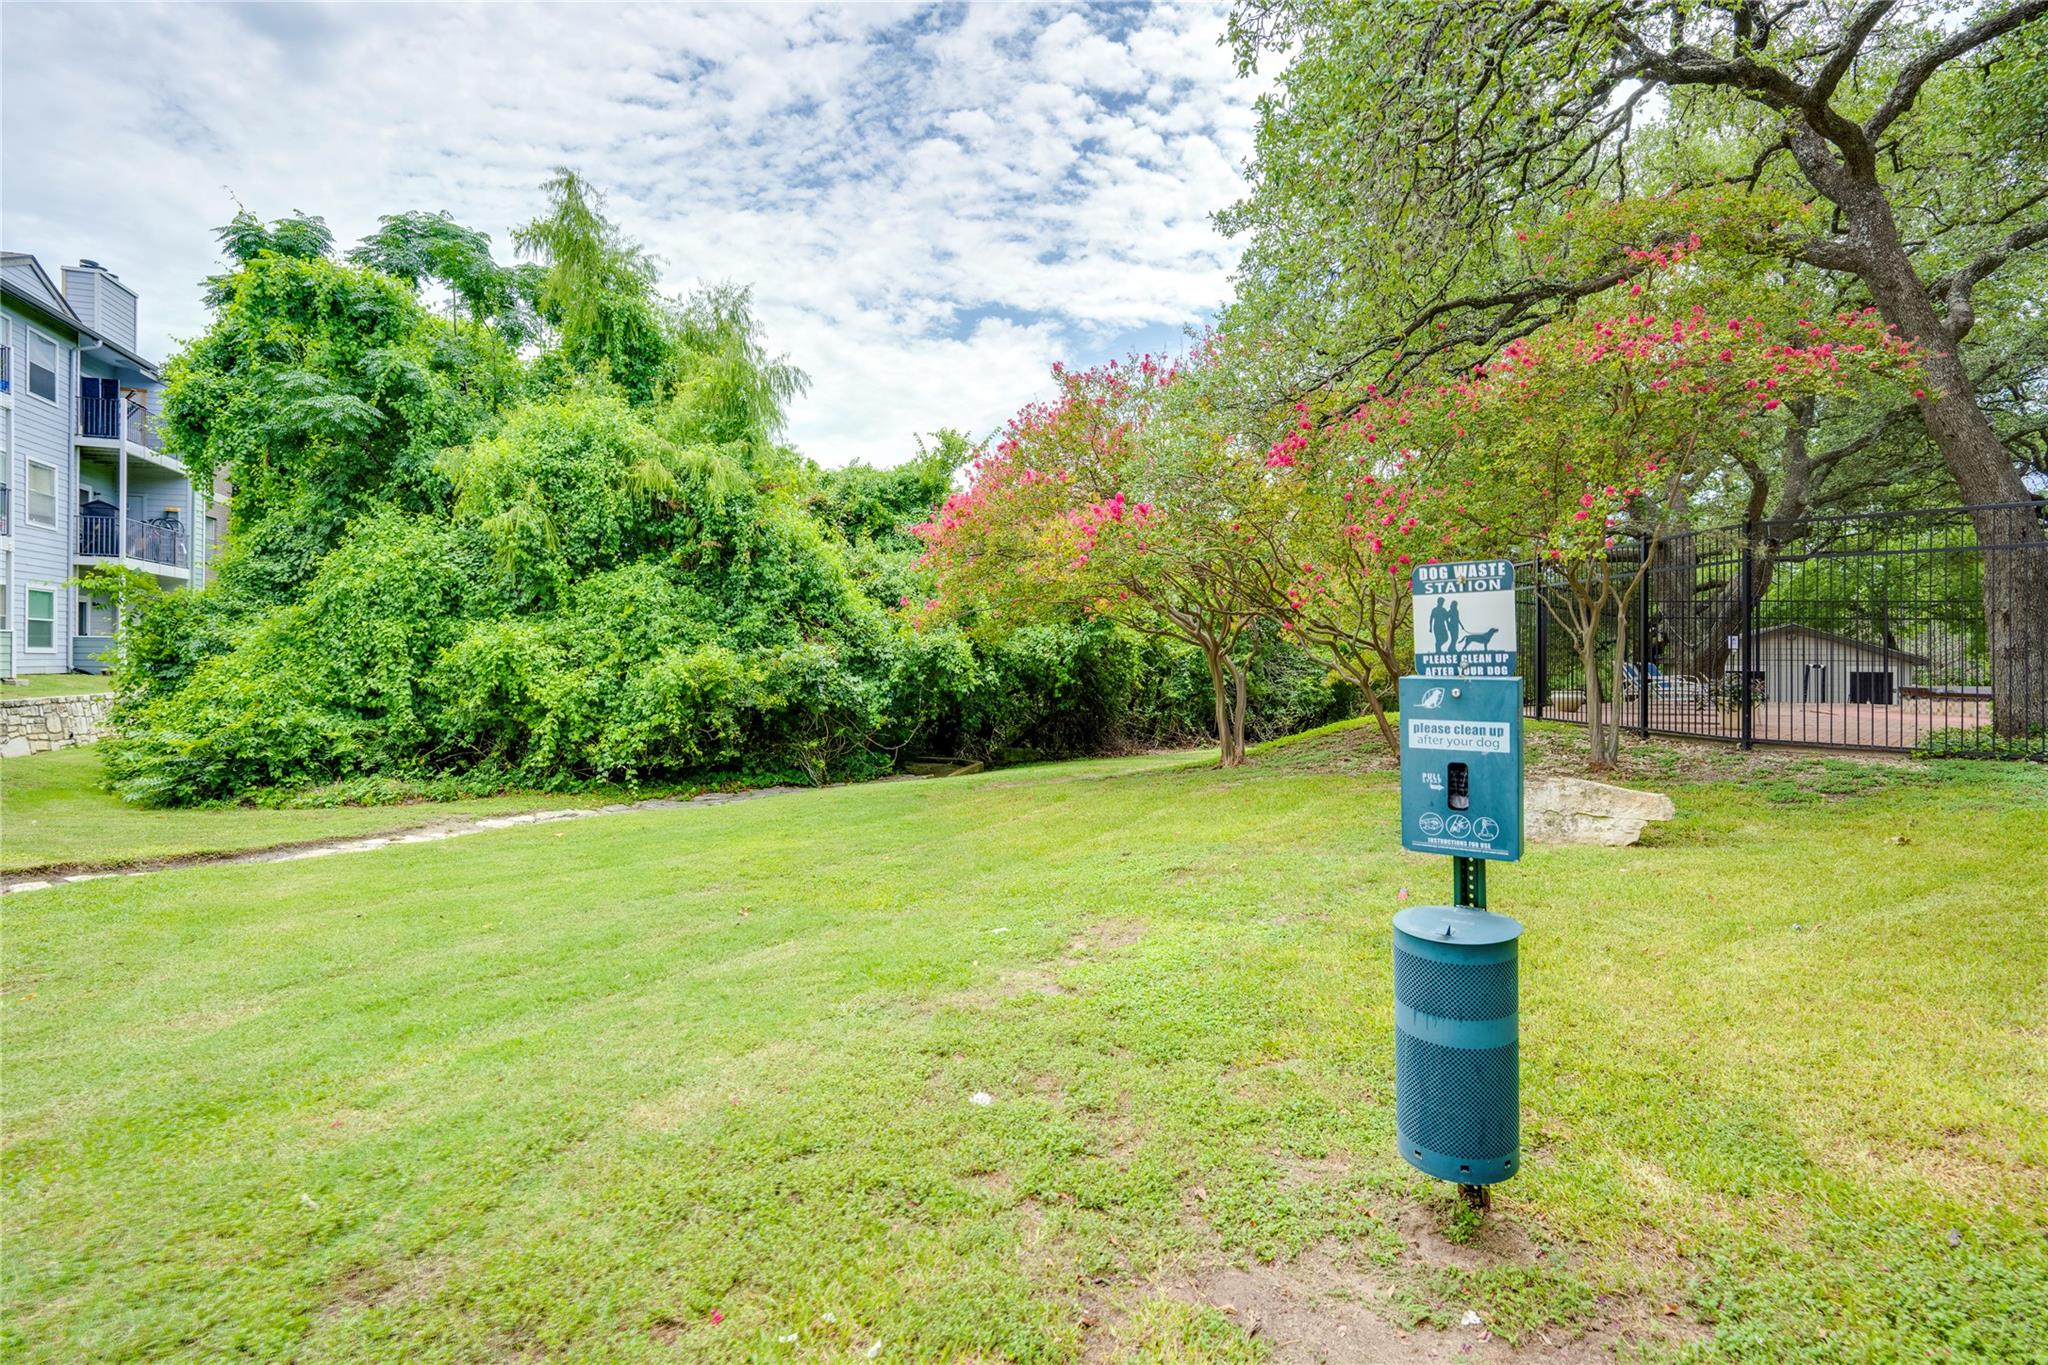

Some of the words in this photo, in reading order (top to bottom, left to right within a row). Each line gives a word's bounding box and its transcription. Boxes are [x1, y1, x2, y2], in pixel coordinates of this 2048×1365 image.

[1419, 567, 1448, 580] DOG
[1453, 562, 1506, 578] WASTE
[1425, 579, 1501, 594] STATION
[1423, 654, 1458, 664] PLEASE
[1461, 654, 1492, 664] CLEAN
[1495, 653, 1509, 663] UP
[1425, 667, 1454, 677] AFTER
[1458, 666, 1484, 676] YOUR
[1487, 666, 1508, 675] DOG
[1413, 722, 1451, 735] please
[1454, 723, 1486, 736] clean
[1490, 726, 1504, 738] up
[1417, 734, 1443, 745] after
[1447, 737, 1473, 747] your
[1476, 737, 1500, 750] dog
[1428, 837, 1467, 847] INSTRUCTIONS
